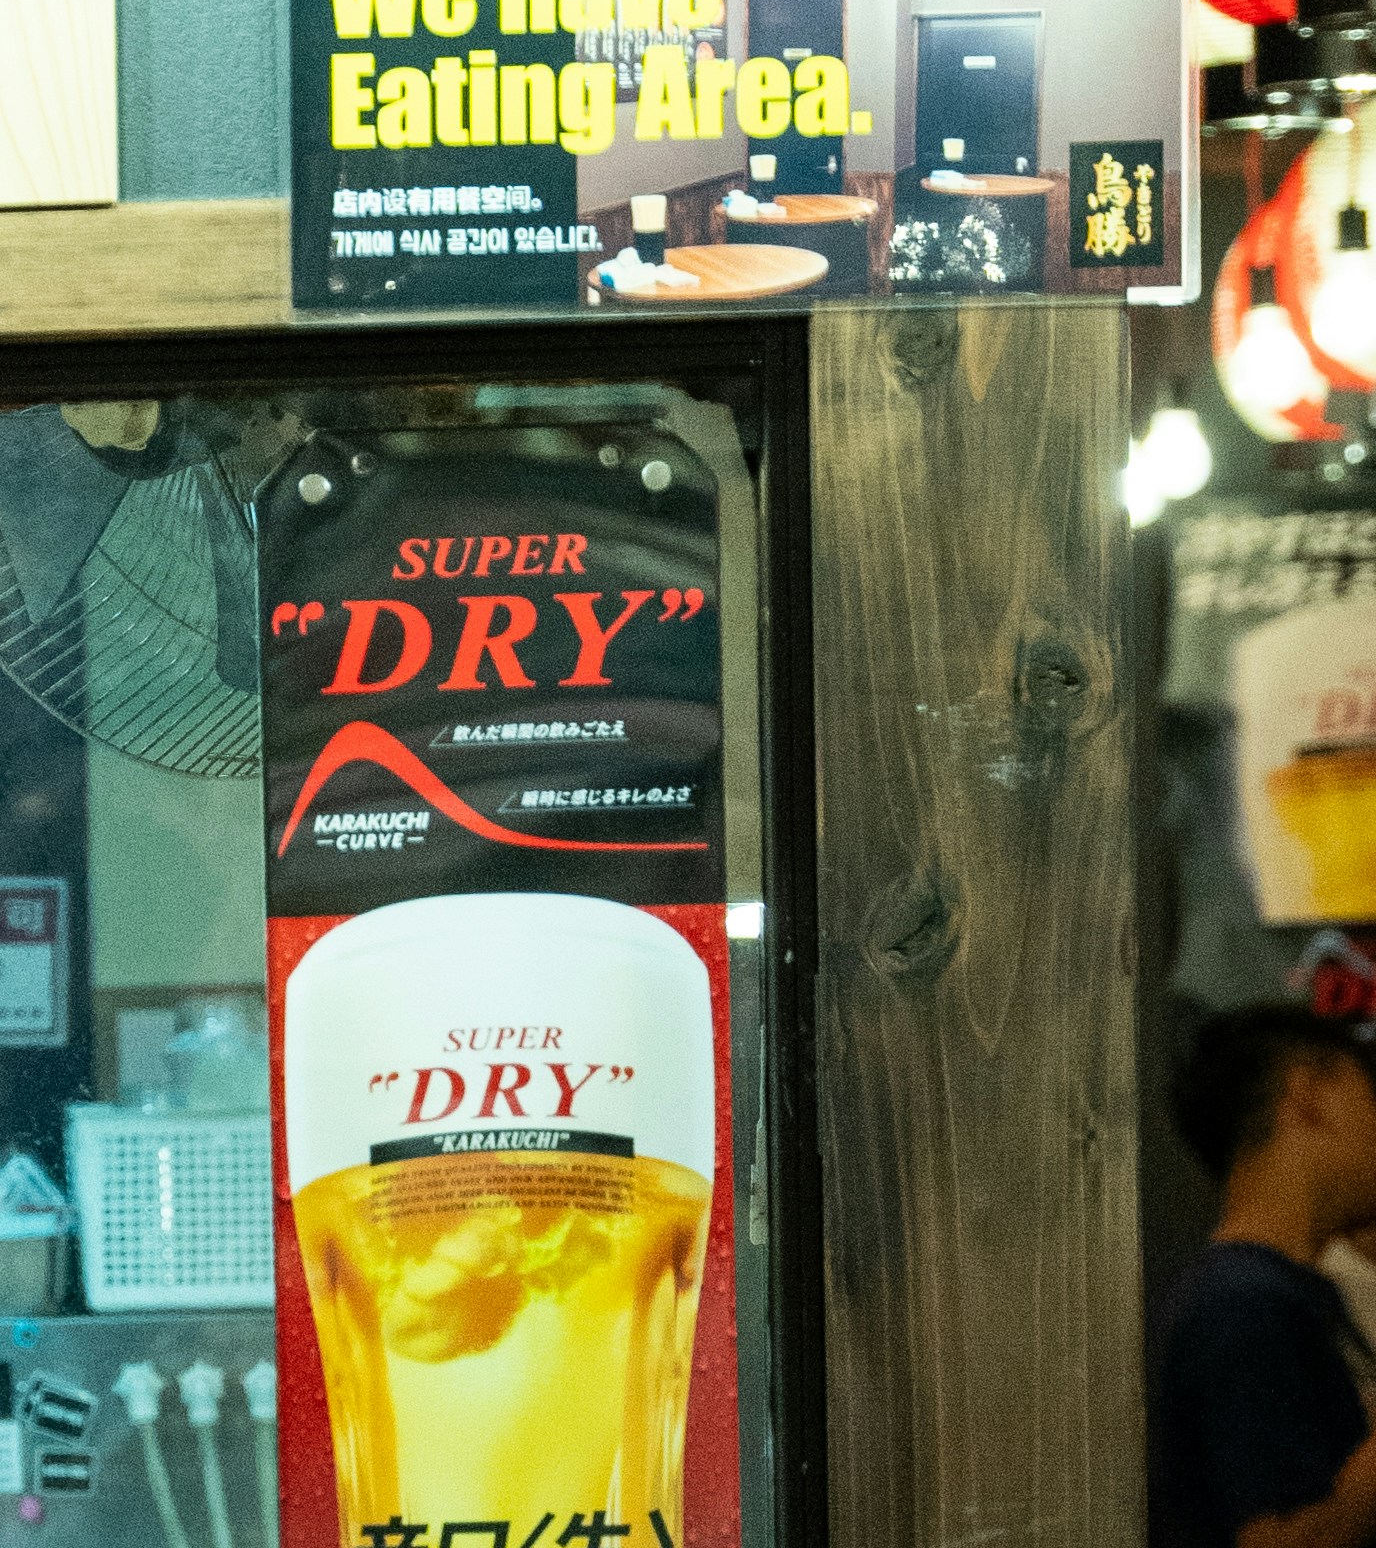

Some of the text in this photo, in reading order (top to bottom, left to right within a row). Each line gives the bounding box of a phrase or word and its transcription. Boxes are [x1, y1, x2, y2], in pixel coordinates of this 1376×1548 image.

[330, 50, 615, 153] Eating
[635, 44, 872, 140] Area.
[393, 534, 587, 580] SUPER
[314, 812, 430, 831] KARAKUCHI
[336, 833, 404, 850] CURVE
[444, 1026, 562, 1052] SUPER
